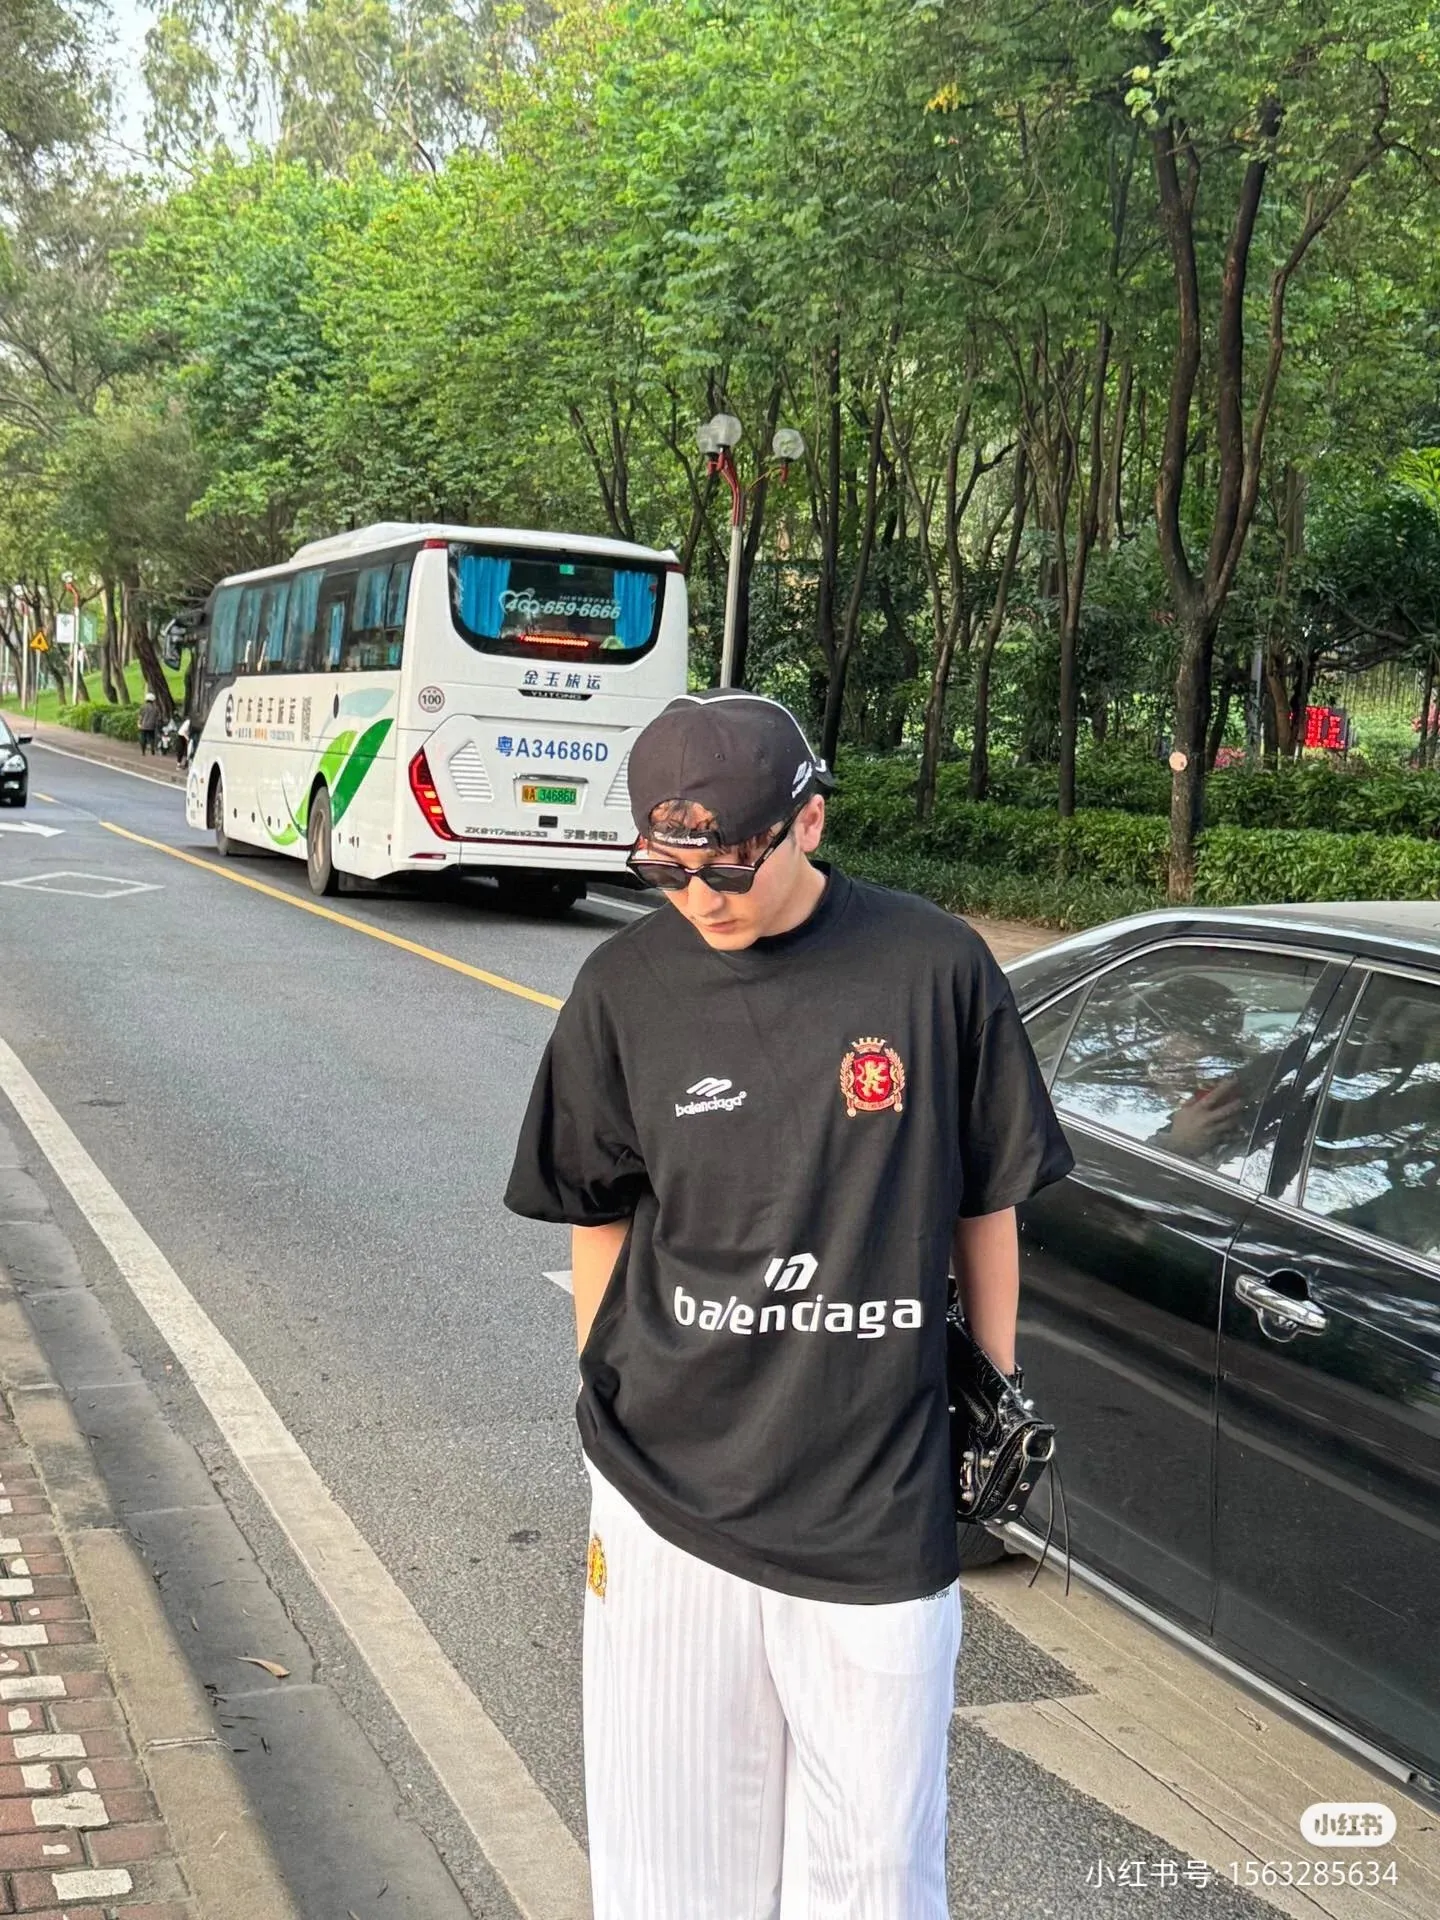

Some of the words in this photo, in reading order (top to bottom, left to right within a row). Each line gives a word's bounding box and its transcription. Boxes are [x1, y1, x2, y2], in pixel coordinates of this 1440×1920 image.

[522, 669, 602, 690] 金玉旅运
[422, 694, 442, 705] 100
[530, 690, 582, 700] YUTONG
[495, 735, 609, 762] 粤A34686D
[675, 1095, 743, 1118] balenciaga
[673, 1285, 923, 1339] balenciaga
